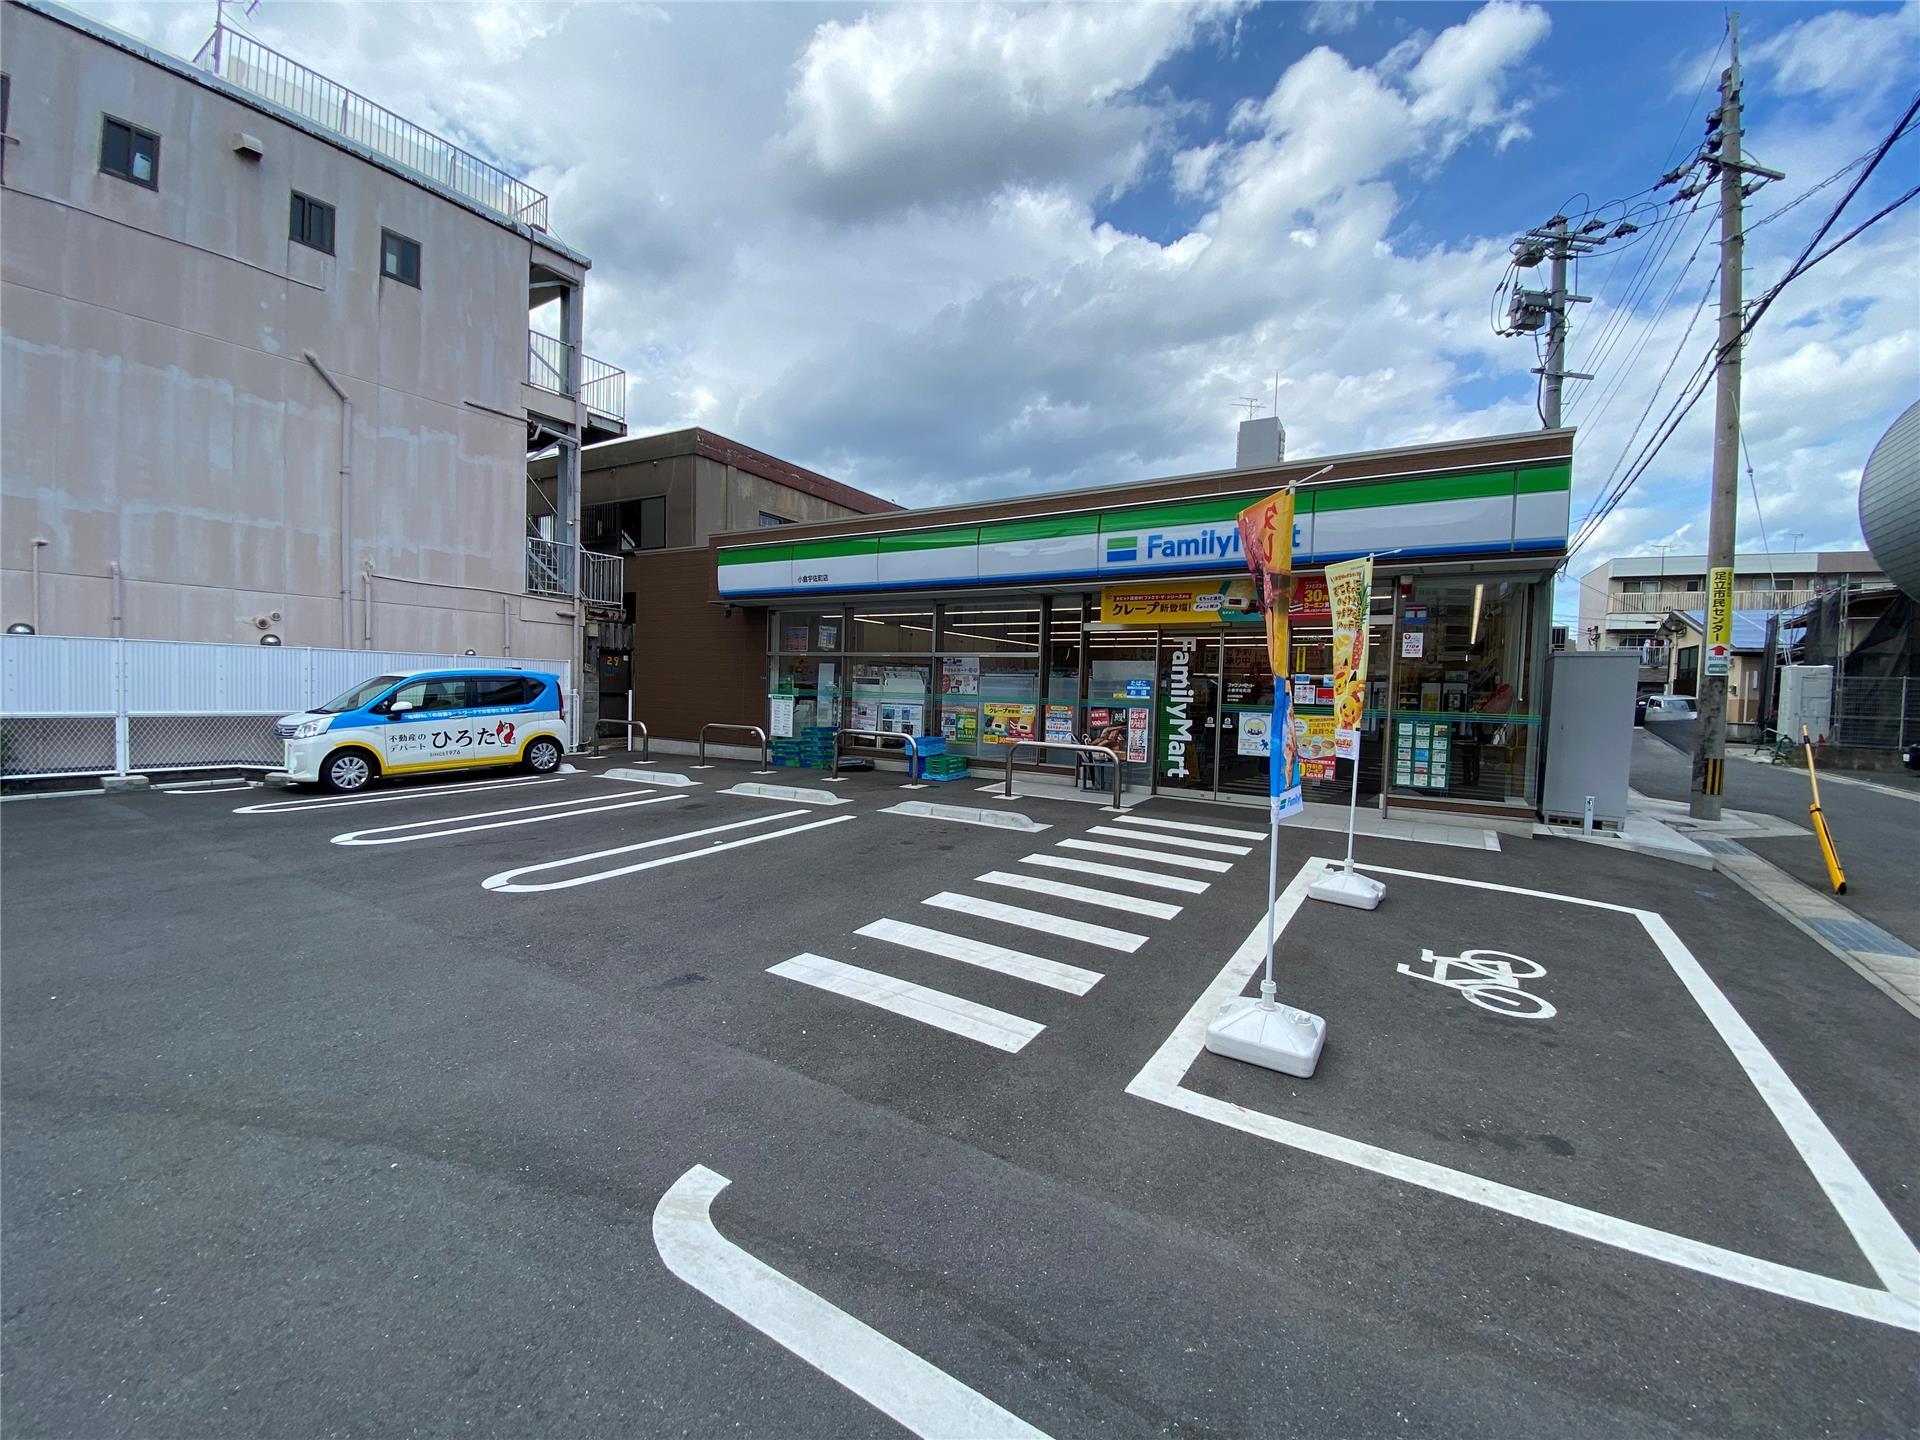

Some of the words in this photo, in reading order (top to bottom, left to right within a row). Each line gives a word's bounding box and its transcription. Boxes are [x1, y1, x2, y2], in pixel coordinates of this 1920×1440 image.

[1148, 528, 1300, 559] Familyt
[1713, 571, 1726, 642] 足立市民センター
[1166, 637, 1197, 778] FamilyMart
[390, 733, 427, 743] 不動産の
[391, 744, 427, 753] デパート
[432, 728, 496, 749] ひろた
